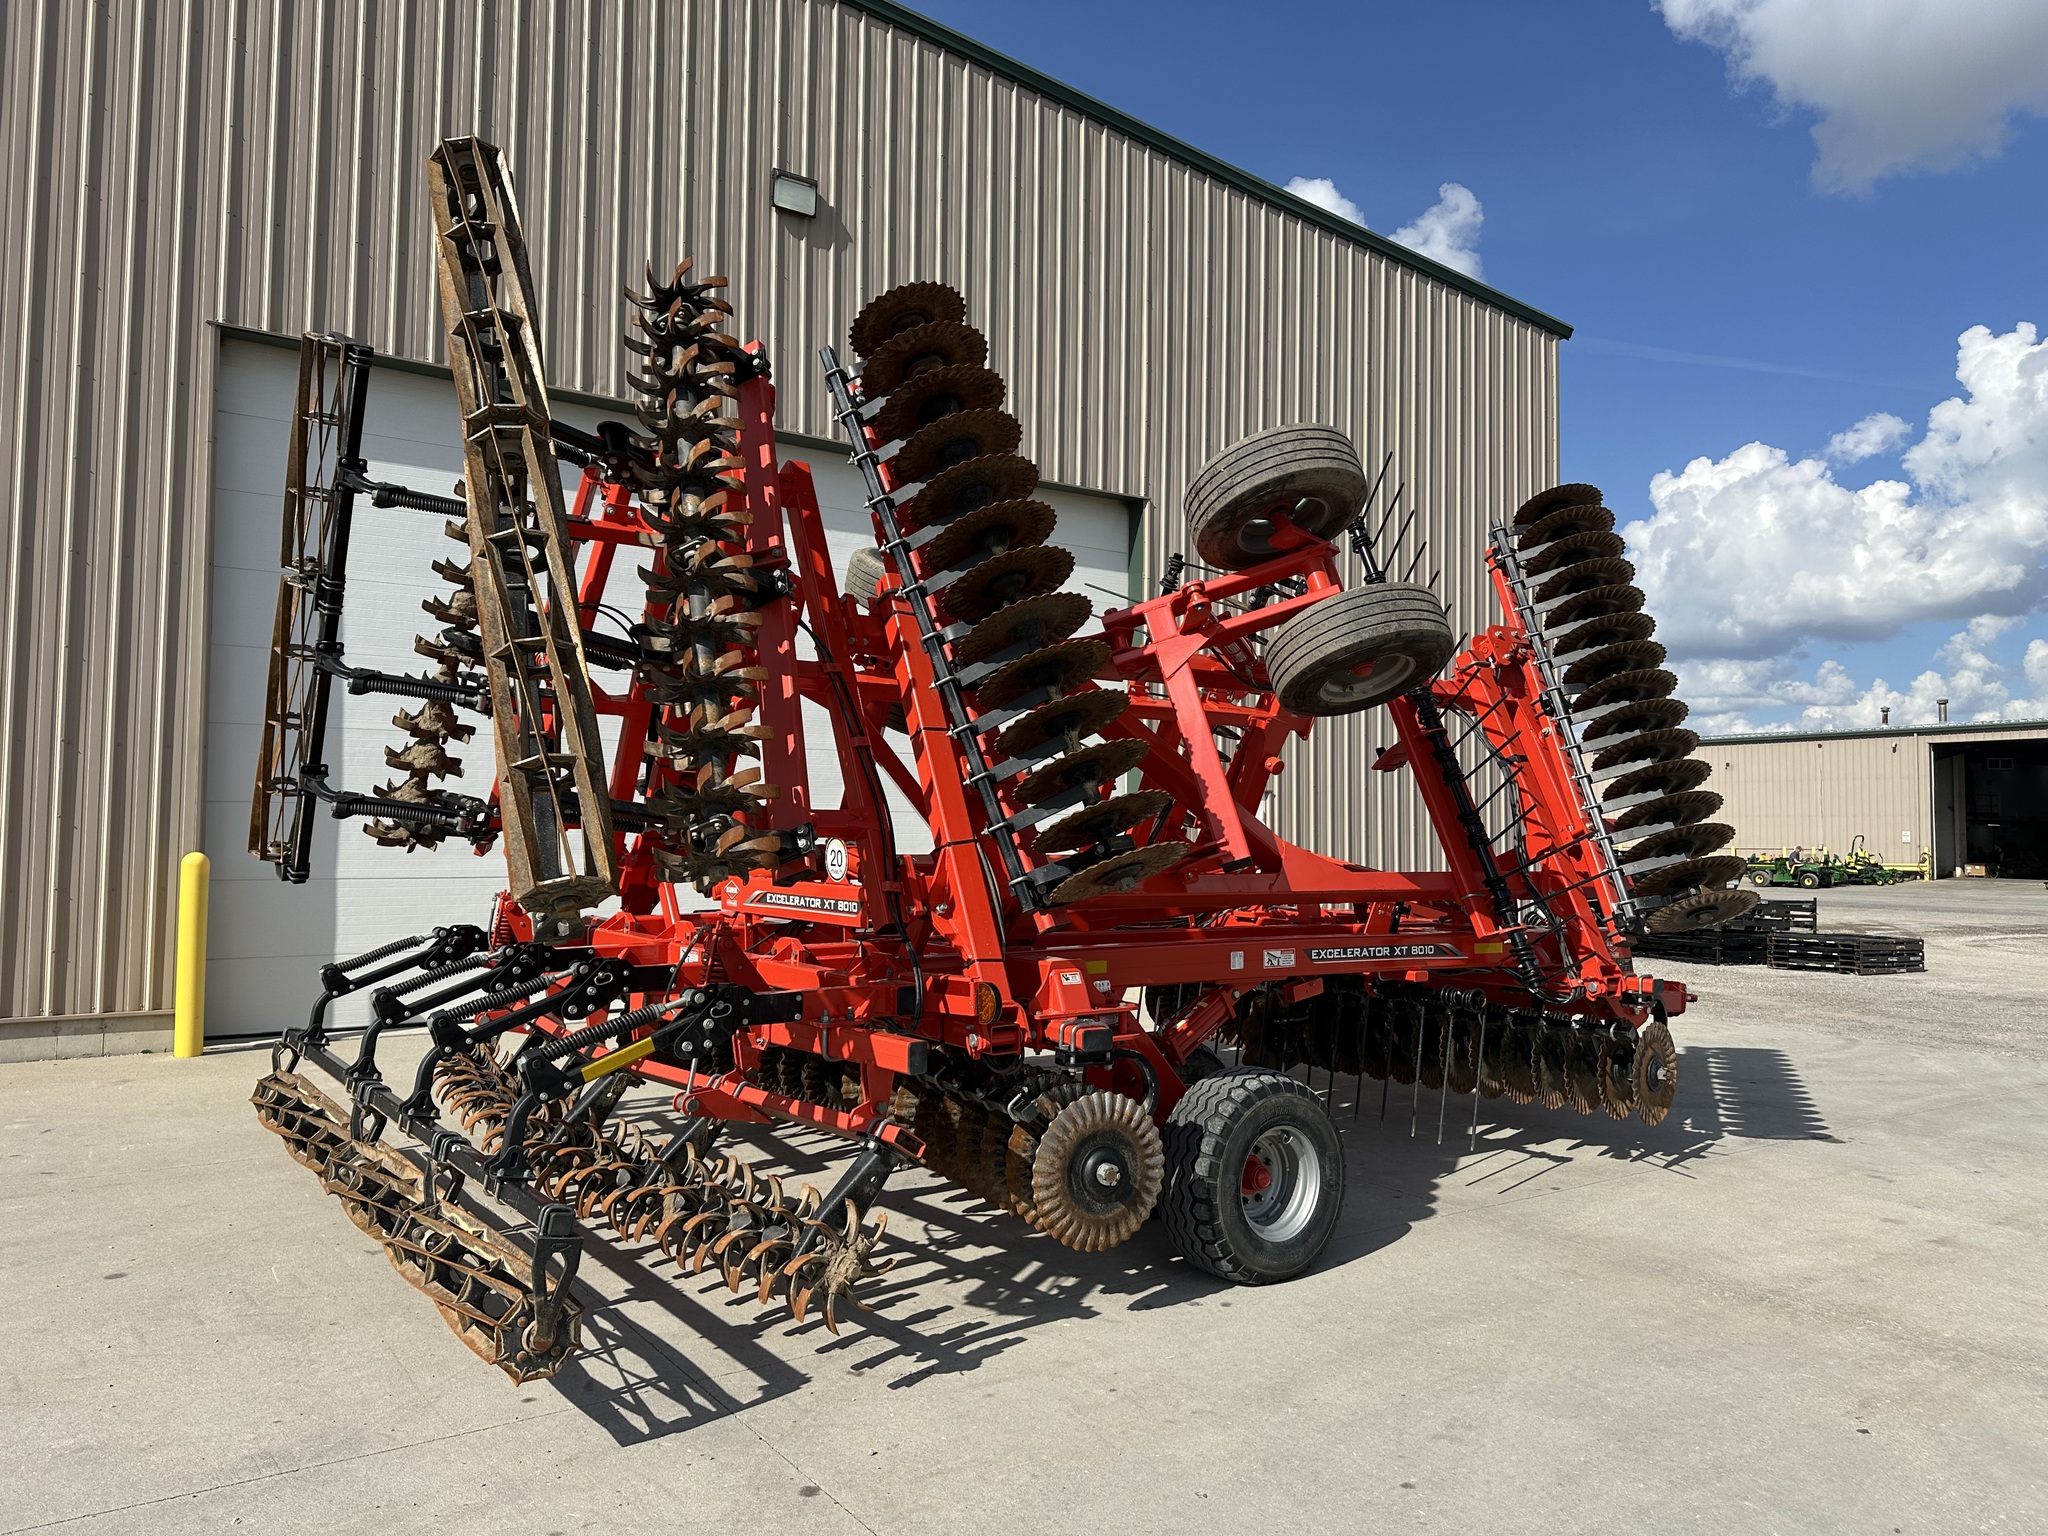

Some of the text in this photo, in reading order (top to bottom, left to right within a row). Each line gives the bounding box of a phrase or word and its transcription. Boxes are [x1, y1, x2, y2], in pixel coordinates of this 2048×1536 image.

[830, 849, 843, 867] 20
[766, 893, 858, 912] EXCELERATOR XT 8010
[1311, 945, 1435, 959] EXCELERATOR XT 8010
